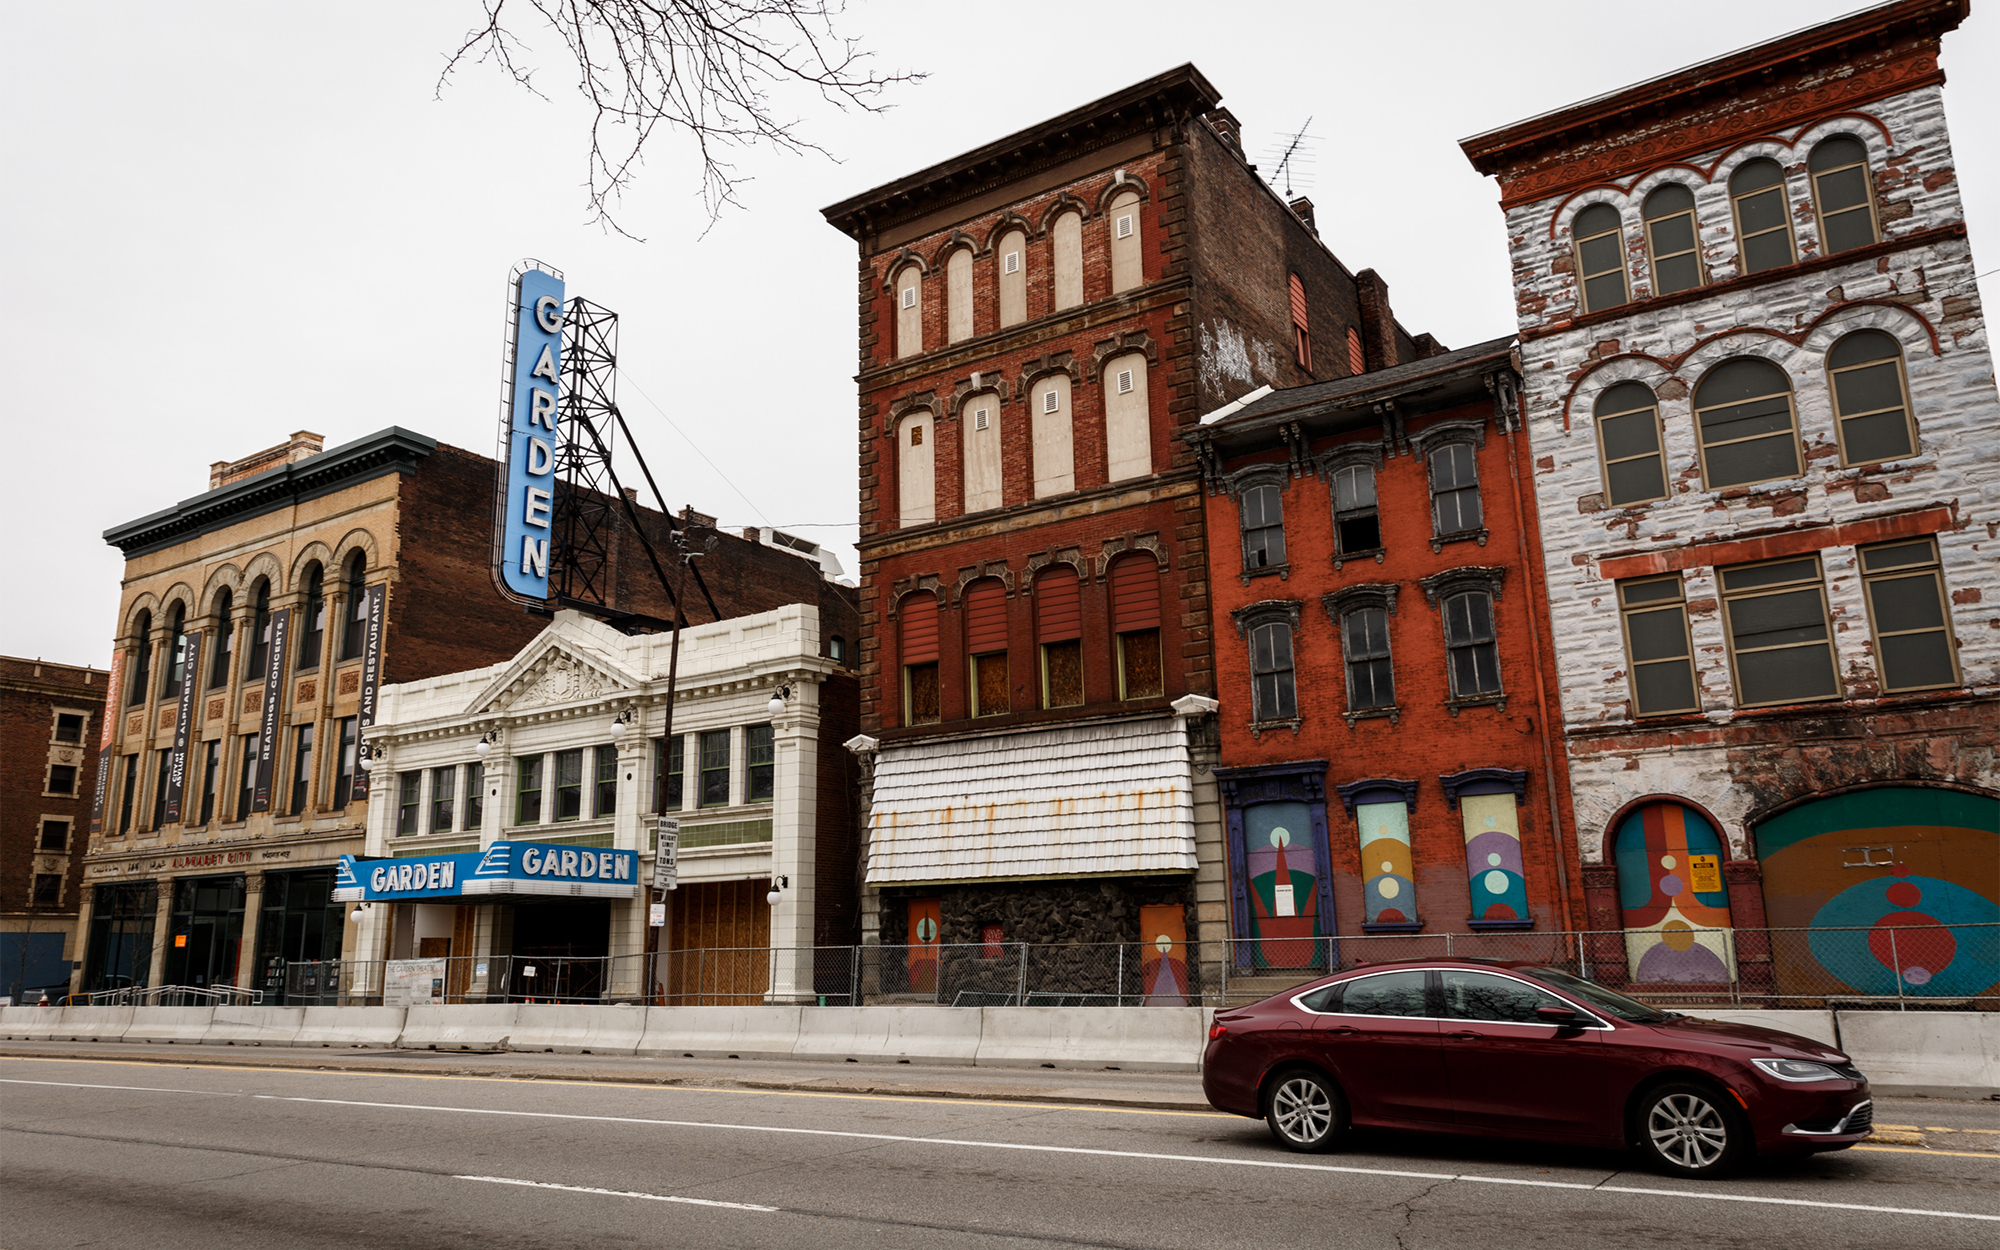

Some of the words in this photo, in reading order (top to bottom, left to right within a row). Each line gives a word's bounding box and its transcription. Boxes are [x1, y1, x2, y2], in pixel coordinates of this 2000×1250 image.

[521, 295, 564, 580] GARDEN
[366, 592, 382, 682] RESTAURANT.
[106, 659, 118, 708] LEASING
[180, 673, 192, 734] ALPHABET
[187, 643, 196, 670] CITY
[263, 692, 276, 760] READINGS,
[271, 617, 285, 689] CONCERTS,
[363, 686, 373, 715] AND
[102, 710, 112, 741] NOW
[358, 718, 370, 765] BOOS
[96, 757, 105, 796] BEDROOM
[99, 756, 109, 805] APARTMENTS
[176, 752, 185, 788] ASYLUM
[660, 820, 678, 829] BRIDGE
[172, 853, 223, 868] ALPHABET
[227, 851, 252, 864] CITY
[370, 861, 455, 893] GARDEN
[522, 848, 630, 880] GARDEN
[659, 857, 674, 865] TONS
[396, 965, 415, 973] GARDEN
